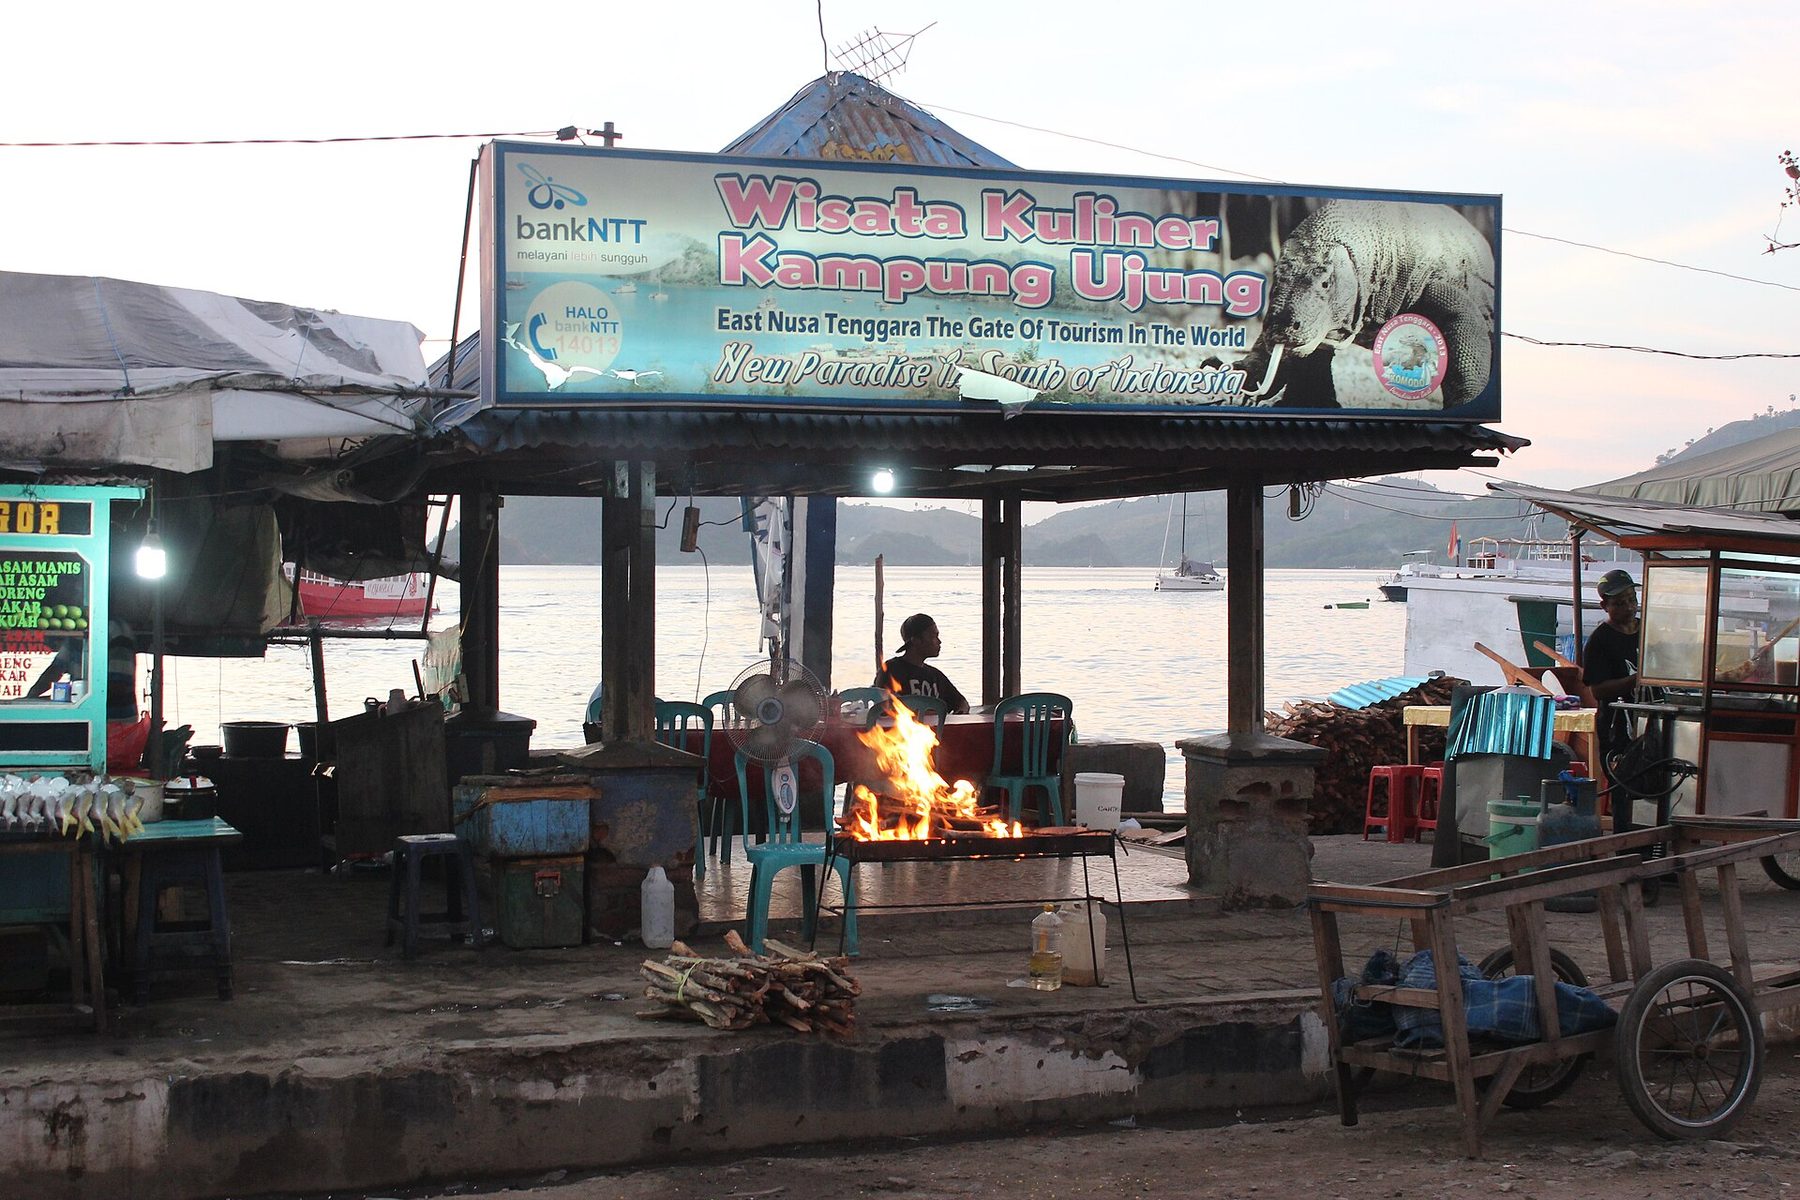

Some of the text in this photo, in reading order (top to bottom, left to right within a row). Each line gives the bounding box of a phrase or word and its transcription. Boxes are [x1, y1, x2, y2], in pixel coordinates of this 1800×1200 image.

[714, 172, 1220, 251] Wisata Kuliner
[517, 214, 647, 244] bankNTT
[517, 250, 648, 266] melayani lebih sungguh
[718, 231, 1267, 318] Kampung Ujung
[565, 306, 608, 319] HALO
[555, 321, 619, 334] bankNTT
[718, 308, 1246, 348] East Nusa Tenggara The Gate Of Tourism In The World
[1399, 315, 1434, 332] Tenggara
[556, 335, 619, 355] 14013
[714, 342, 792, 383] New
[793, 351, 932, 388] Paradise
[1070, 365, 1110, 394] of
[0, 561, 81, 574] SAM MANIS
[18, 574, 58, 587] ASAM
[0, 601, 41, 613] AKAR
[0, 658, 32, 669] ENG
[0, 685, 22, 696] AH
